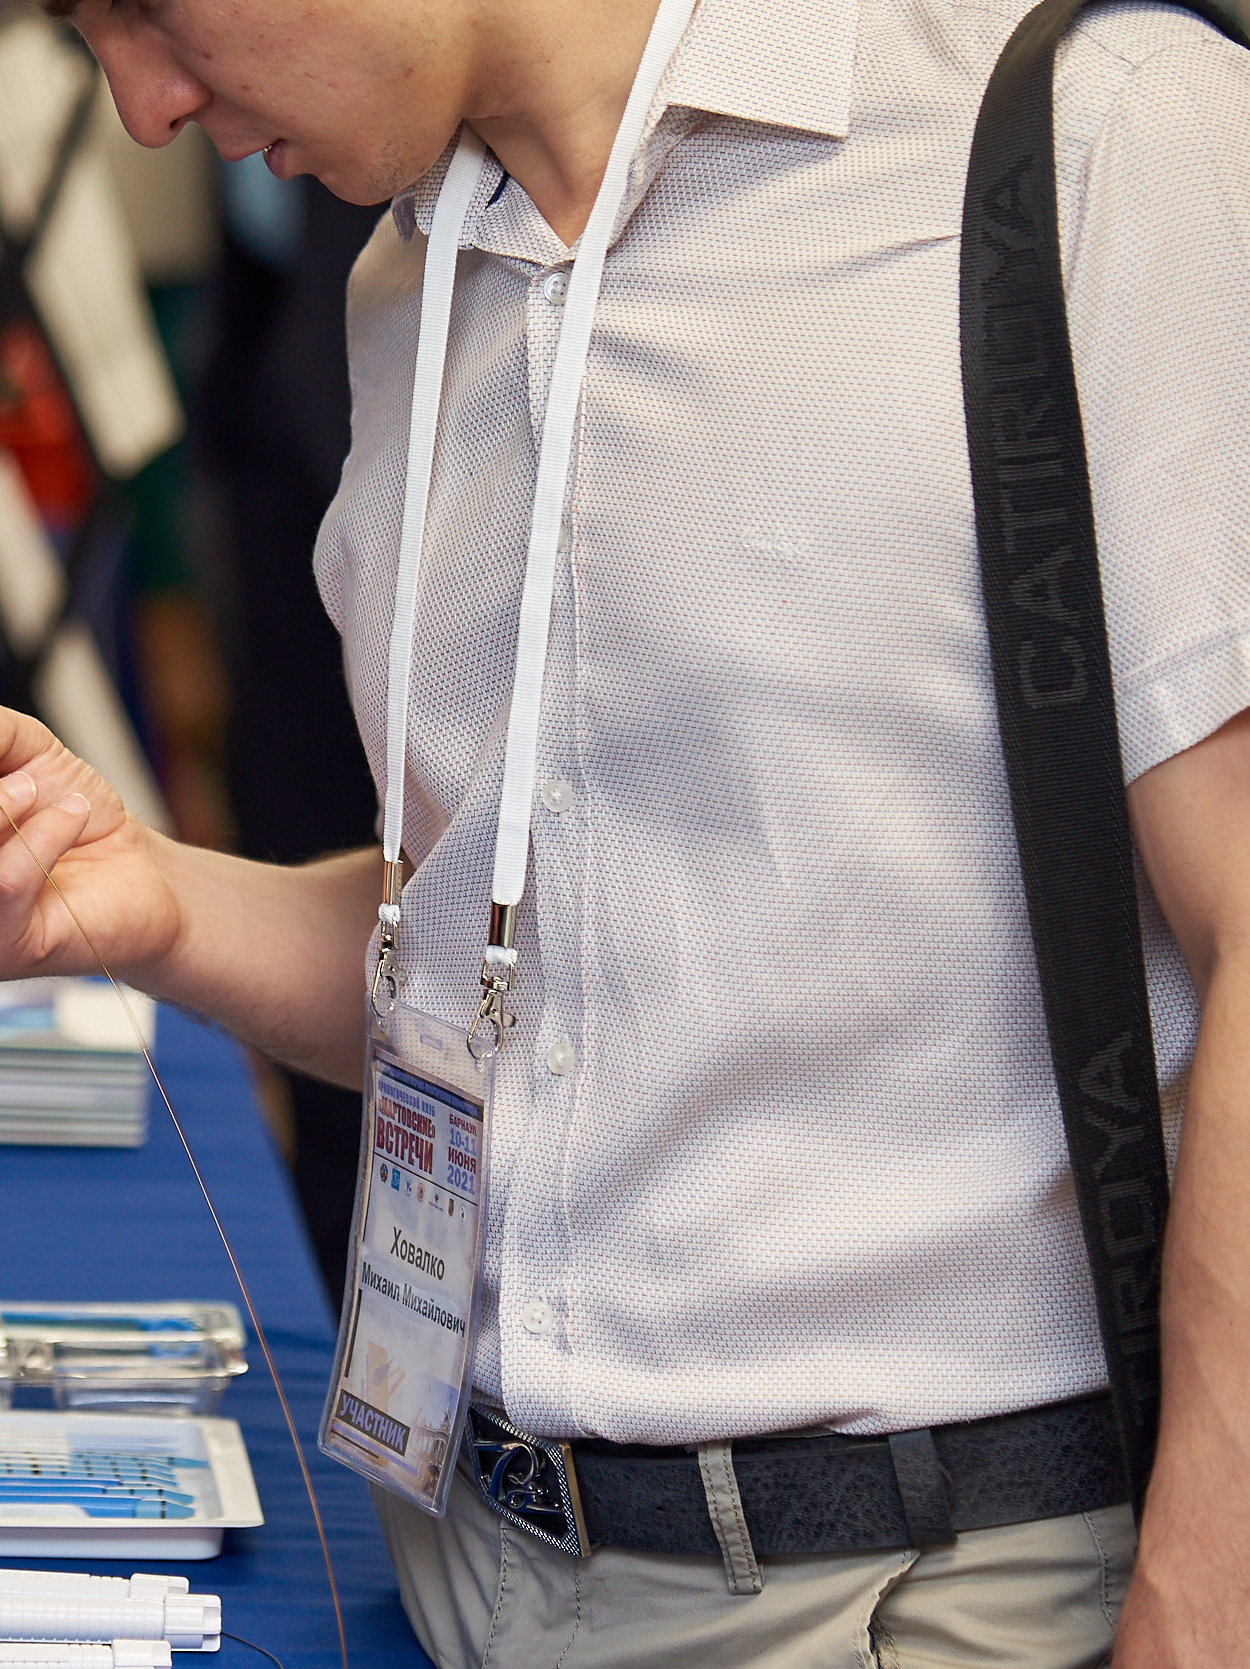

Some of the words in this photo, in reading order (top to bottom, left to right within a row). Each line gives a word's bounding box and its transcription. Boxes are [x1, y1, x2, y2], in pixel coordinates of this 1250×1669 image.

[376, 1116, 434, 1176] ВСТРЕЧИ
[449, 1113, 477, 1137] БАРНАУЛ
[449, 1127, 477, 1156] 10-11
[447, 1164, 475, 1196] 2021
[448, 1146, 477, 1175] ИЮНЯ
[390, 1226, 446, 1281] Ховалко
[361, 1261, 401, 1301] Михаил
[402, 1285, 467, 1338] Михайлович
[340, 1394, 406, 1447] УЧАСТНИК
